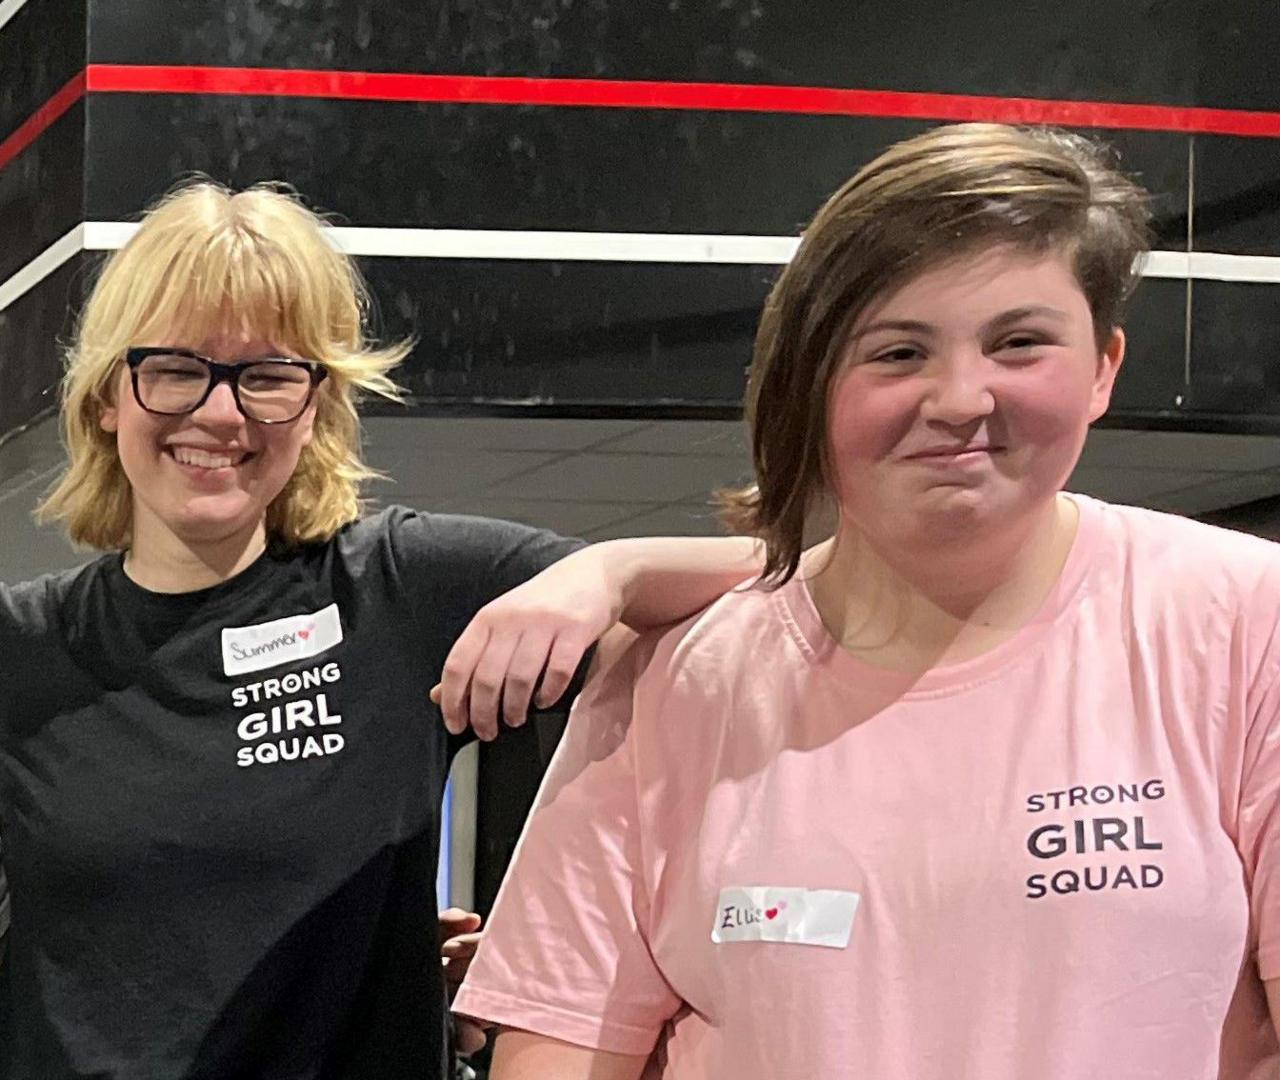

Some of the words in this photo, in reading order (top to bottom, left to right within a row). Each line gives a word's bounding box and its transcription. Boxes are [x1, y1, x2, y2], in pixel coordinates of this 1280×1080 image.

[229, 631, 298, 662] Summer
[231, 662, 341, 708] STRONG
[236, 693, 342, 741] GIRL
[236, 733, 345, 767] SQUAD
[1026, 778, 1166, 813] STRONG
[1026, 815, 1163, 859] GIRL
[1026, 864, 1164, 899] SQUAD
